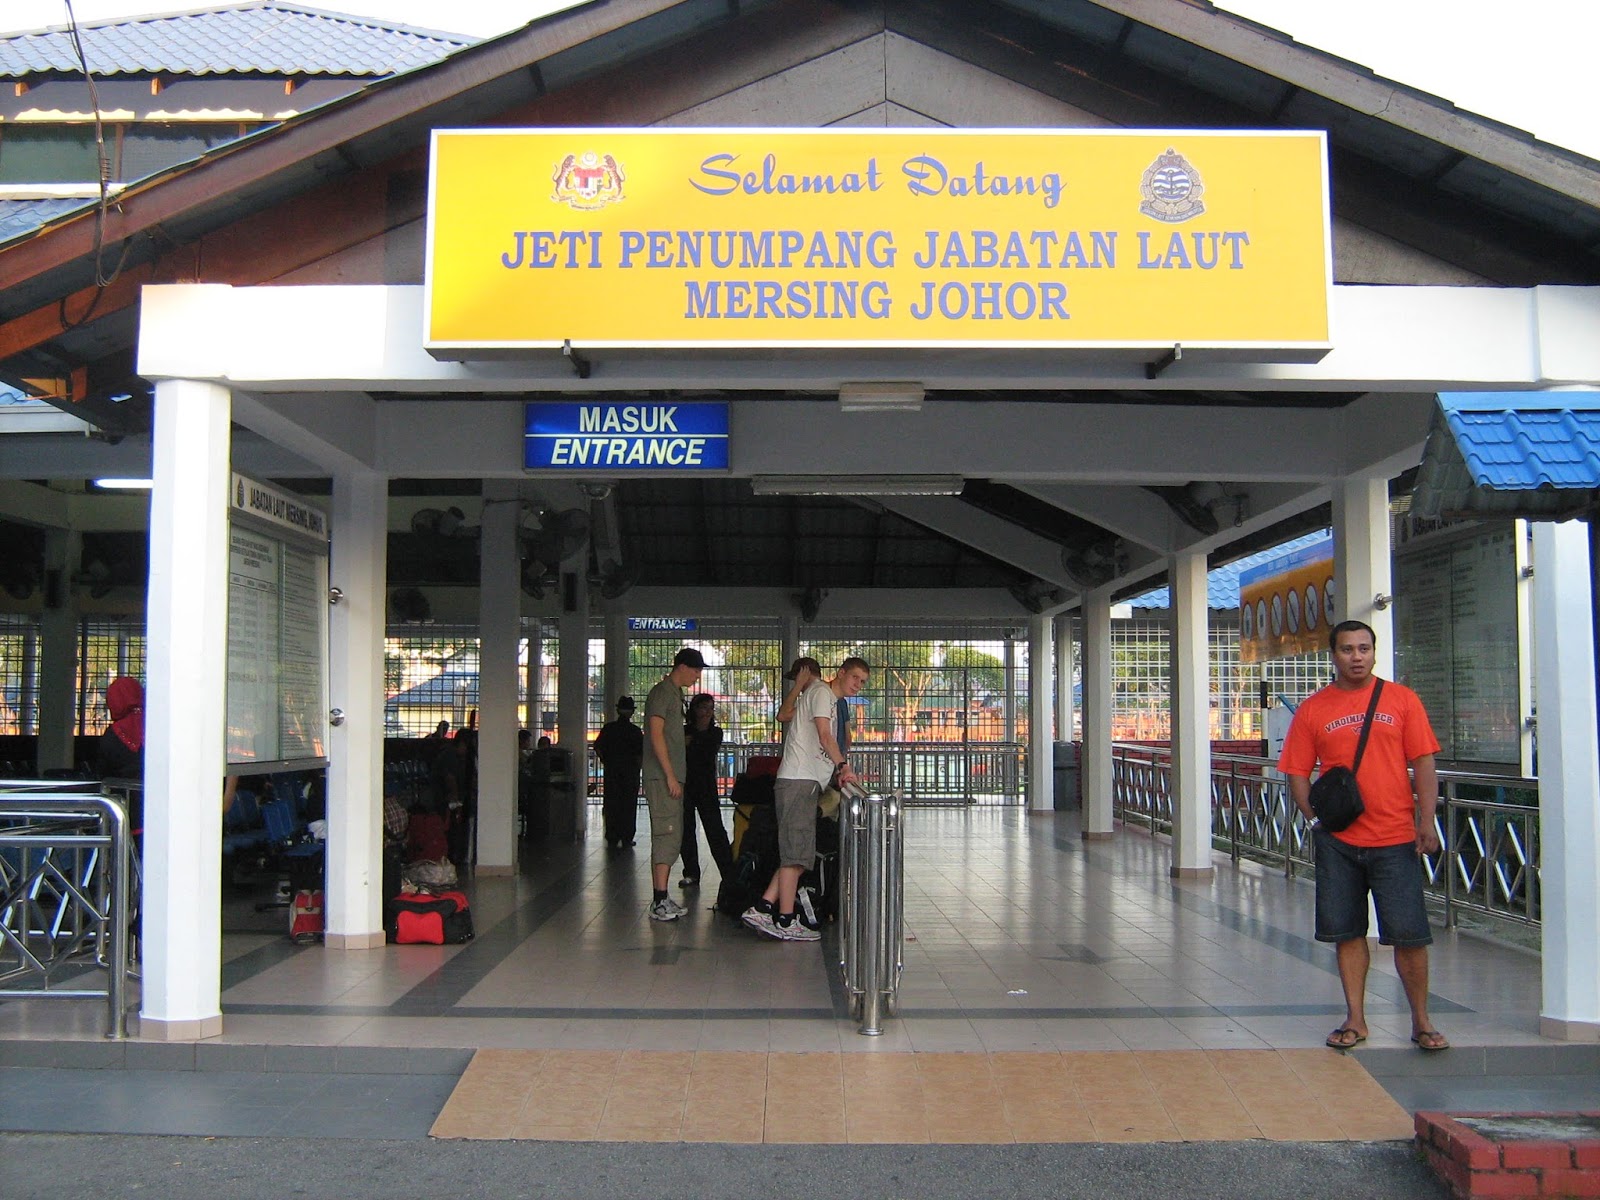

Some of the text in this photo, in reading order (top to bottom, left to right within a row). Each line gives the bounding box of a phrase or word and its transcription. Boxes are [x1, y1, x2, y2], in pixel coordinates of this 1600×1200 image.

[688, 152, 1067, 209] Selamat Datang
[501, 231, 1250, 269] JETI PENUMPANG JABATAN LAUT
[684, 281, 1070, 320] MERSING JOHOR
[579, 406, 678, 433] MASUK
[550, 438, 706, 465] ENTRANCE
[632, 617, 687, 629] ENTRANCE
[1373, 713, 1393, 725] ECH
